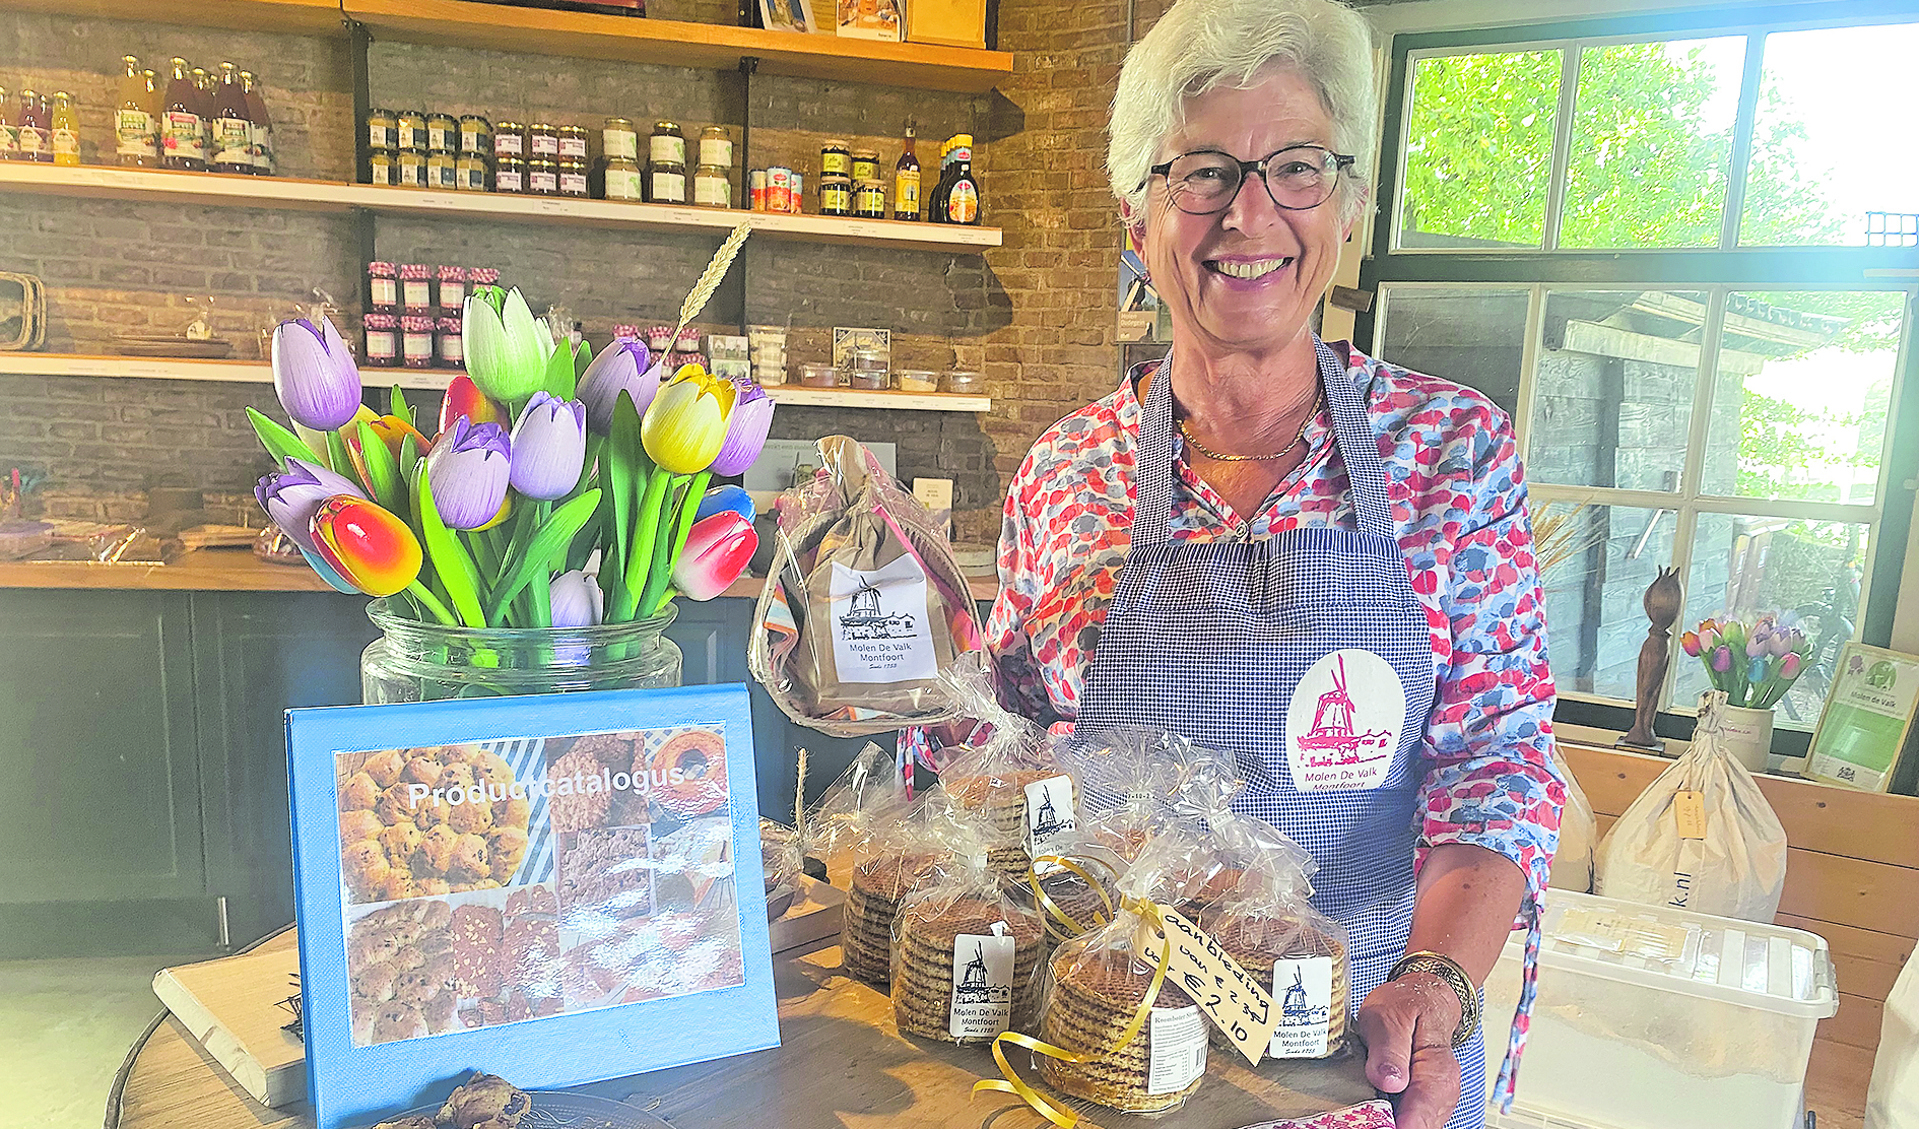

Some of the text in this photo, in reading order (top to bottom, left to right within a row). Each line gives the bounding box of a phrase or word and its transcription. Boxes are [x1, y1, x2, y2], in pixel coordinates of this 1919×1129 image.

[849, 642, 912, 652] Molen De Valk
[860, 653, 904, 662] Montfoort
[1304, 767, 1378, 782] Molen De Valk
[408, 763, 686, 809] Productcatalogus
[1313, 781, 1365, 790] Montfoort
[1144, 946, 1176, 972] vor
[1179, 945, 1208, 974] van
[1164, 914, 1270, 1025] aanbieding
[953, 1008, 977, 1016] Molen
[961, 1018, 999, 1026] Montfoort
[1312, 1028, 1327, 1036] Valk
[1281, 1039, 1320, 1047] Montfoort
